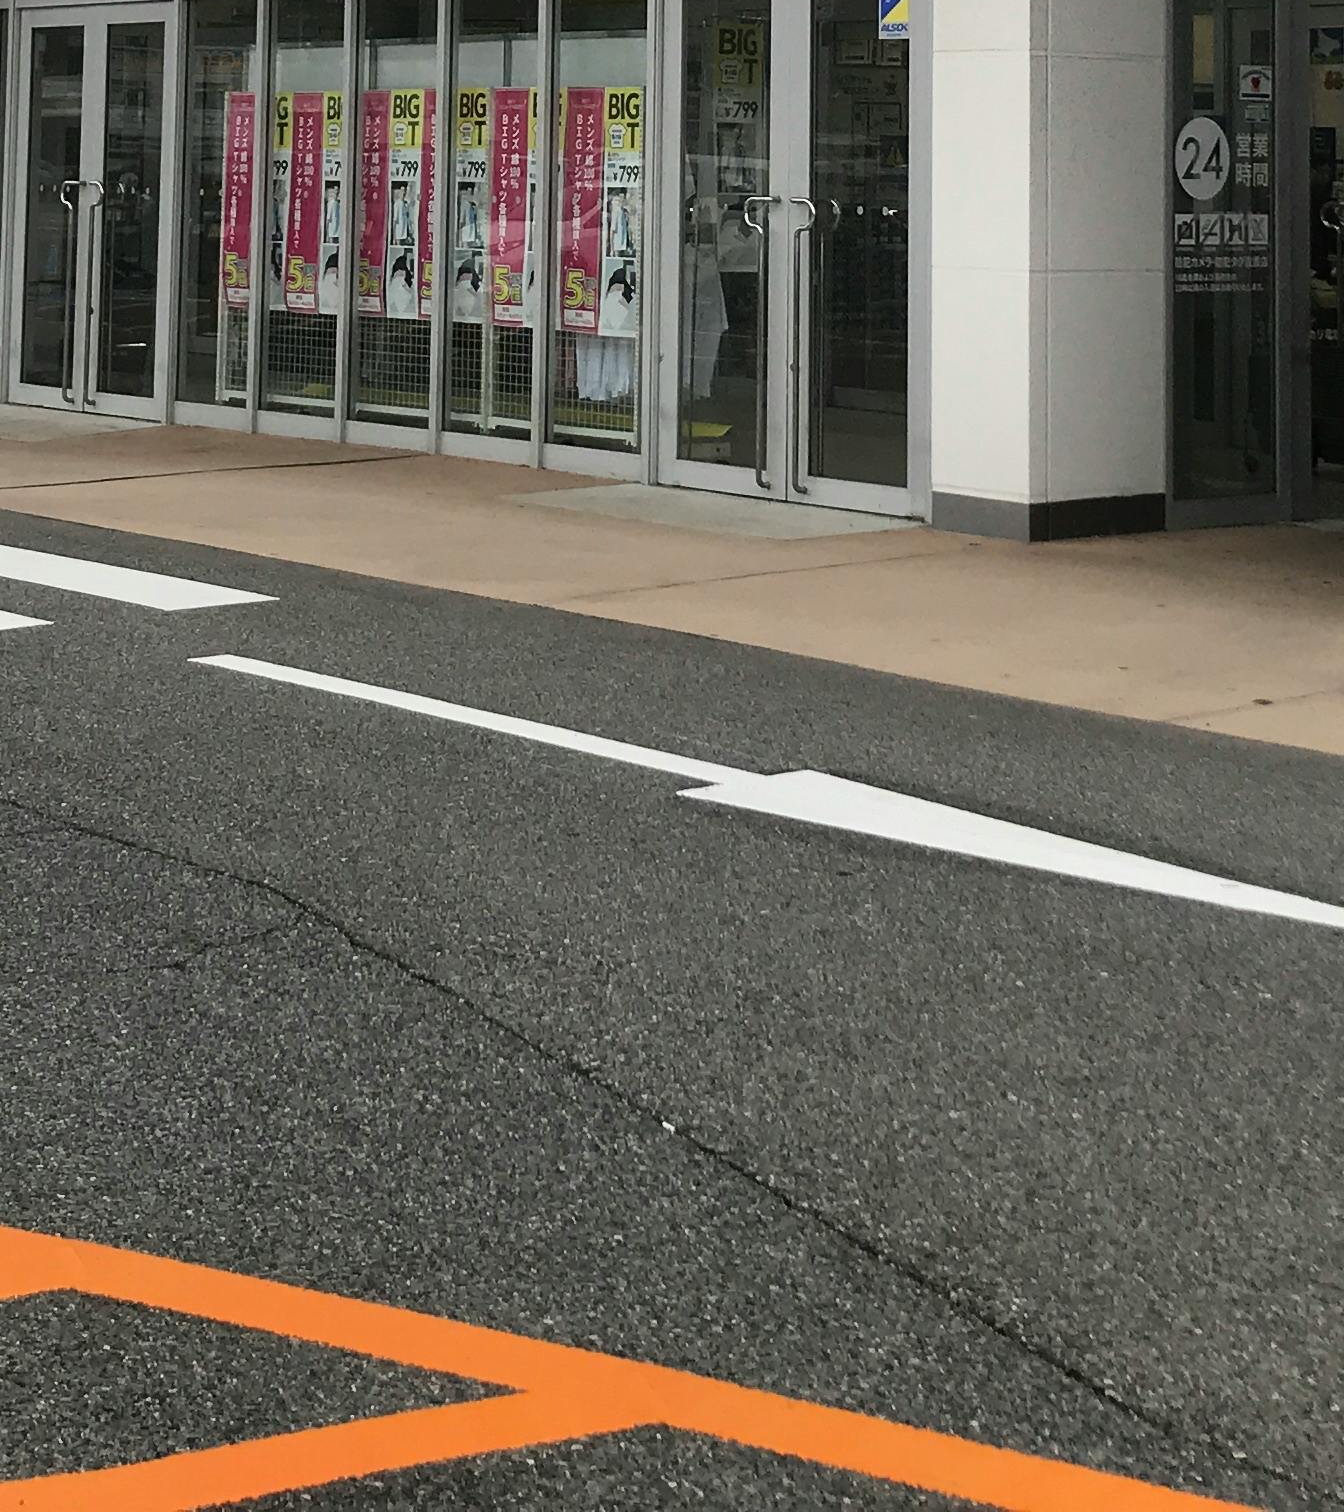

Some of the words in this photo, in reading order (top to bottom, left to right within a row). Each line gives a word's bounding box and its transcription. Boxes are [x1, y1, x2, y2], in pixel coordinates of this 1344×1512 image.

[719, 29, 758, 56] BIG
[744, 59, 758, 84] T
[327, 97, 341, 120] BI
[392, 94, 420, 120] BIG
[459, 93, 487, 119] BIG
[608, 92, 641, 120] BIG
[407, 121, 419, 146] T
[474, 121, 487, 146] T
[627, 122, 640, 149] T
[1182, 136, 1223, 180] 24
